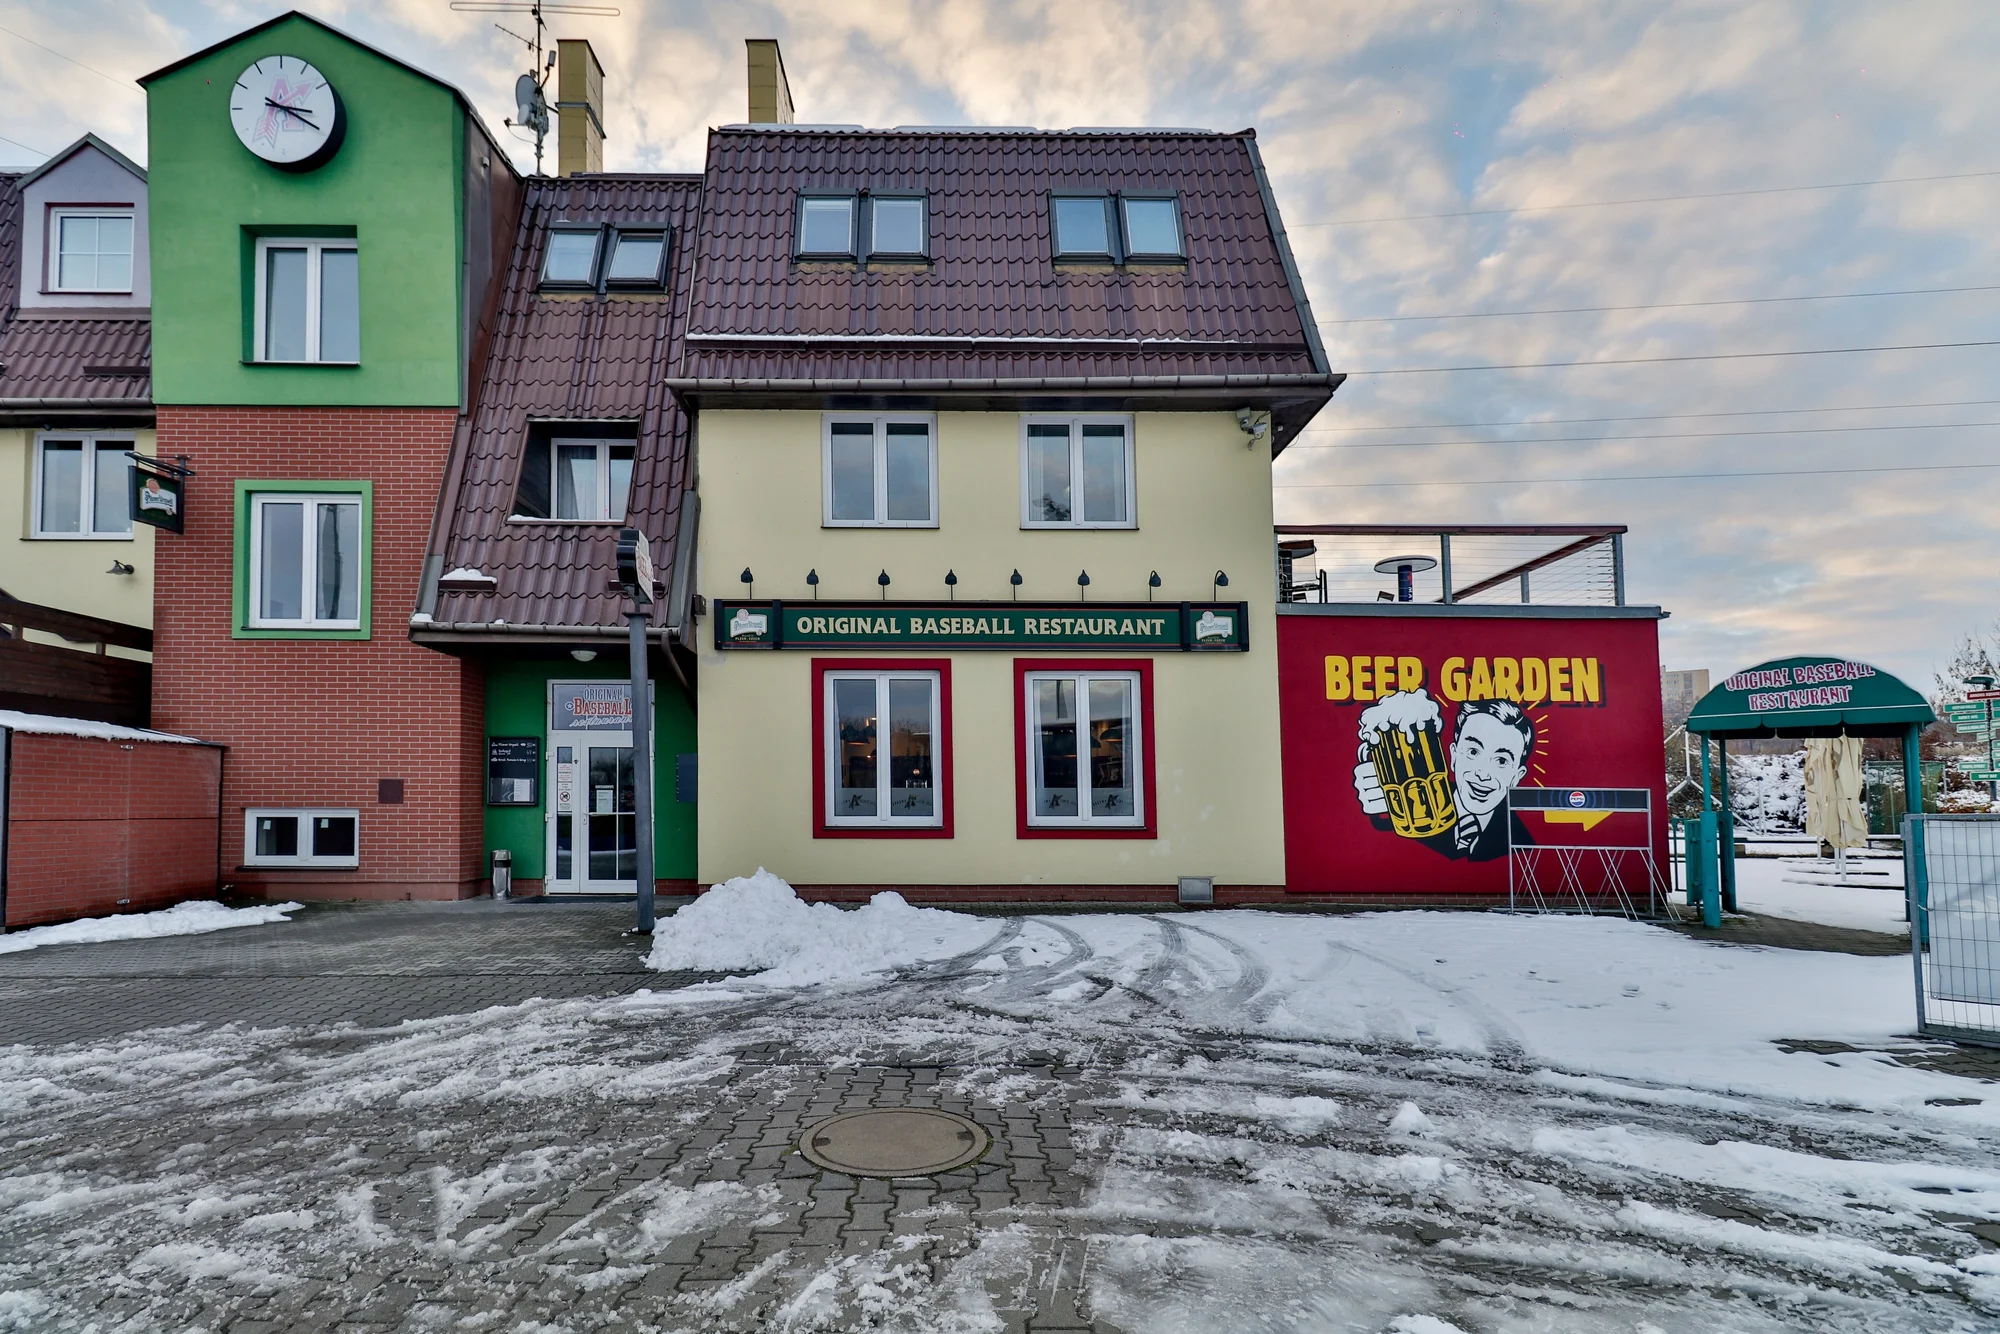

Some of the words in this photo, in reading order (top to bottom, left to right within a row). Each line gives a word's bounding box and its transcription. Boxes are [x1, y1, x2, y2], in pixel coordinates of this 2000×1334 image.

[797, 616, 901, 634] ORIGINAL
[910, 617, 1015, 635] BASEBALL
[1024, 617, 1165, 636] RESTAURANT
[1324, 655, 1423, 700] BEER
[1440, 656, 1599, 702] GARDEN
[1725, 667, 1792, 692] ORIGINAL
[1793, 661, 1876, 684] BASEBALL
[584, 688, 623, 700] ORIGINAL
[1748, 685, 1852, 711] RESTAURANT
[573, 697, 632, 715] BASEBALL
